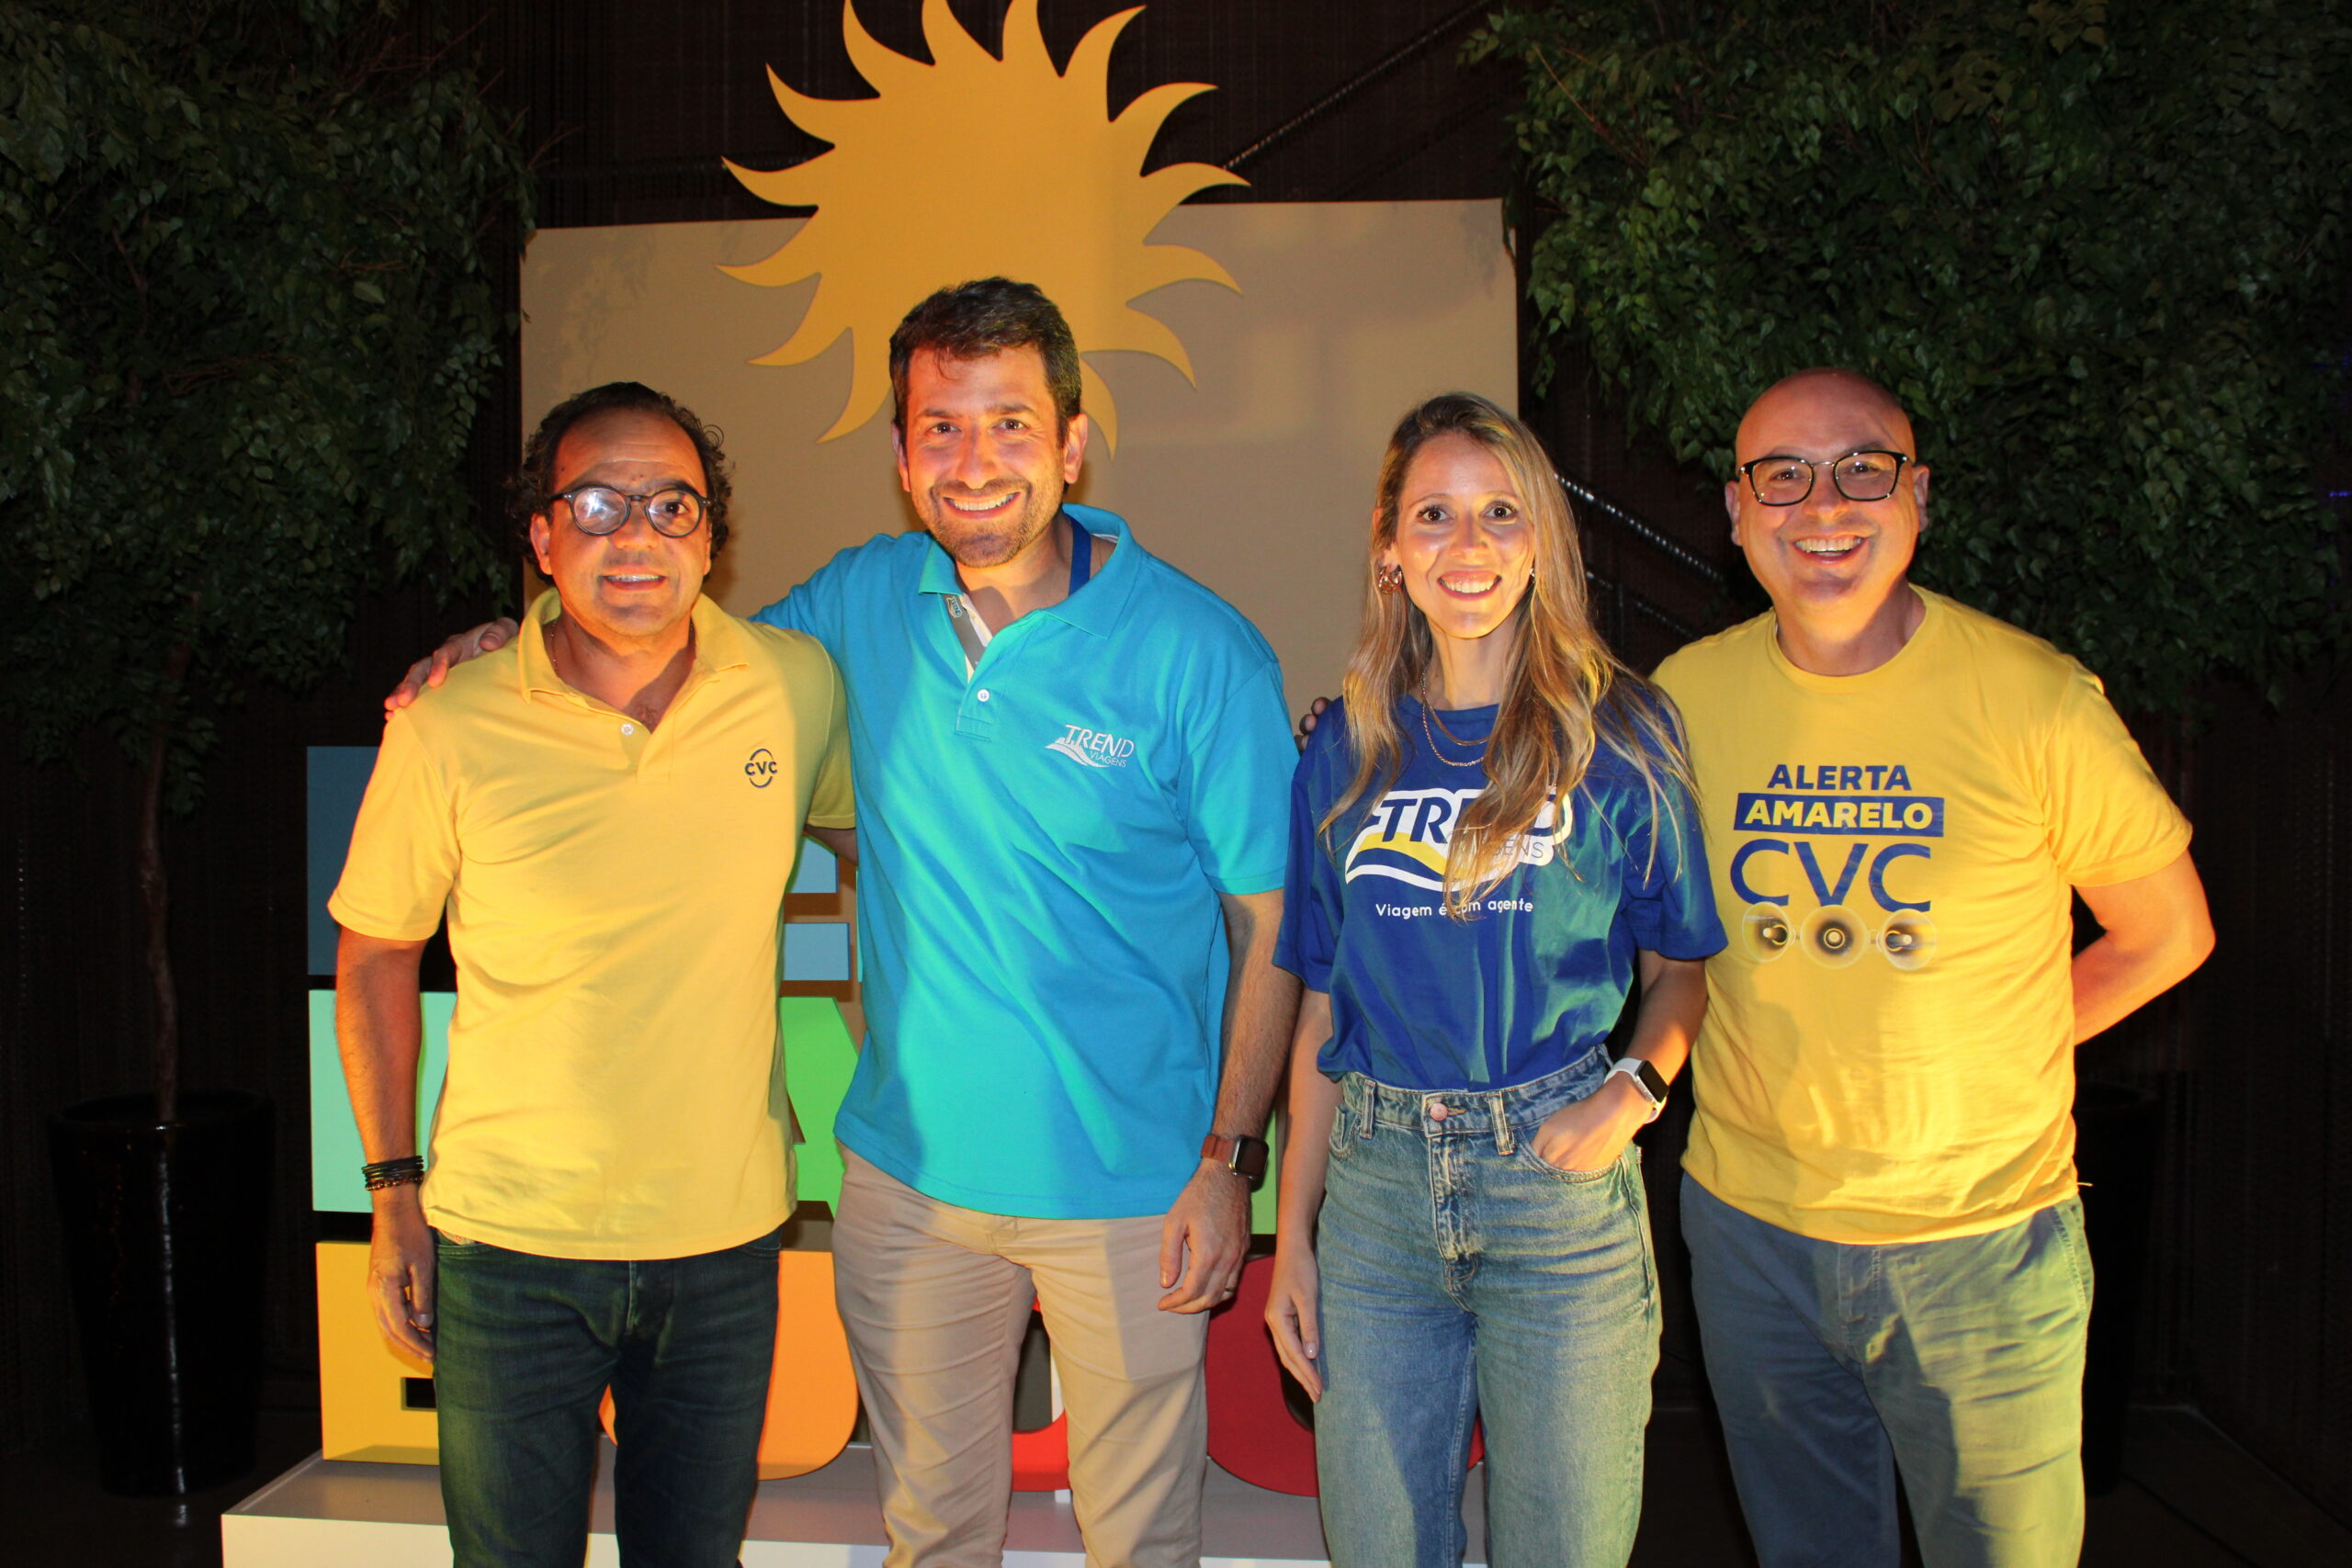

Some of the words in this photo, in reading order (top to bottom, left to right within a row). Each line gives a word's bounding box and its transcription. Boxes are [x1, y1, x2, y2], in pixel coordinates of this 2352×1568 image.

[1065, 724, 1135, 758] TREND
[744, 761, 778, 776] CVC
[1090, 750, 1127, 768] VIAGENS
[1767, 764, 1912, 791] ALERTA
[1744, 799, 1933, 829] AMARELO
[1730, 838, 1932, 913] CVC
[1375, 903, 1432, 919] Viagem
[1487, 897, 1533, 913] agente
